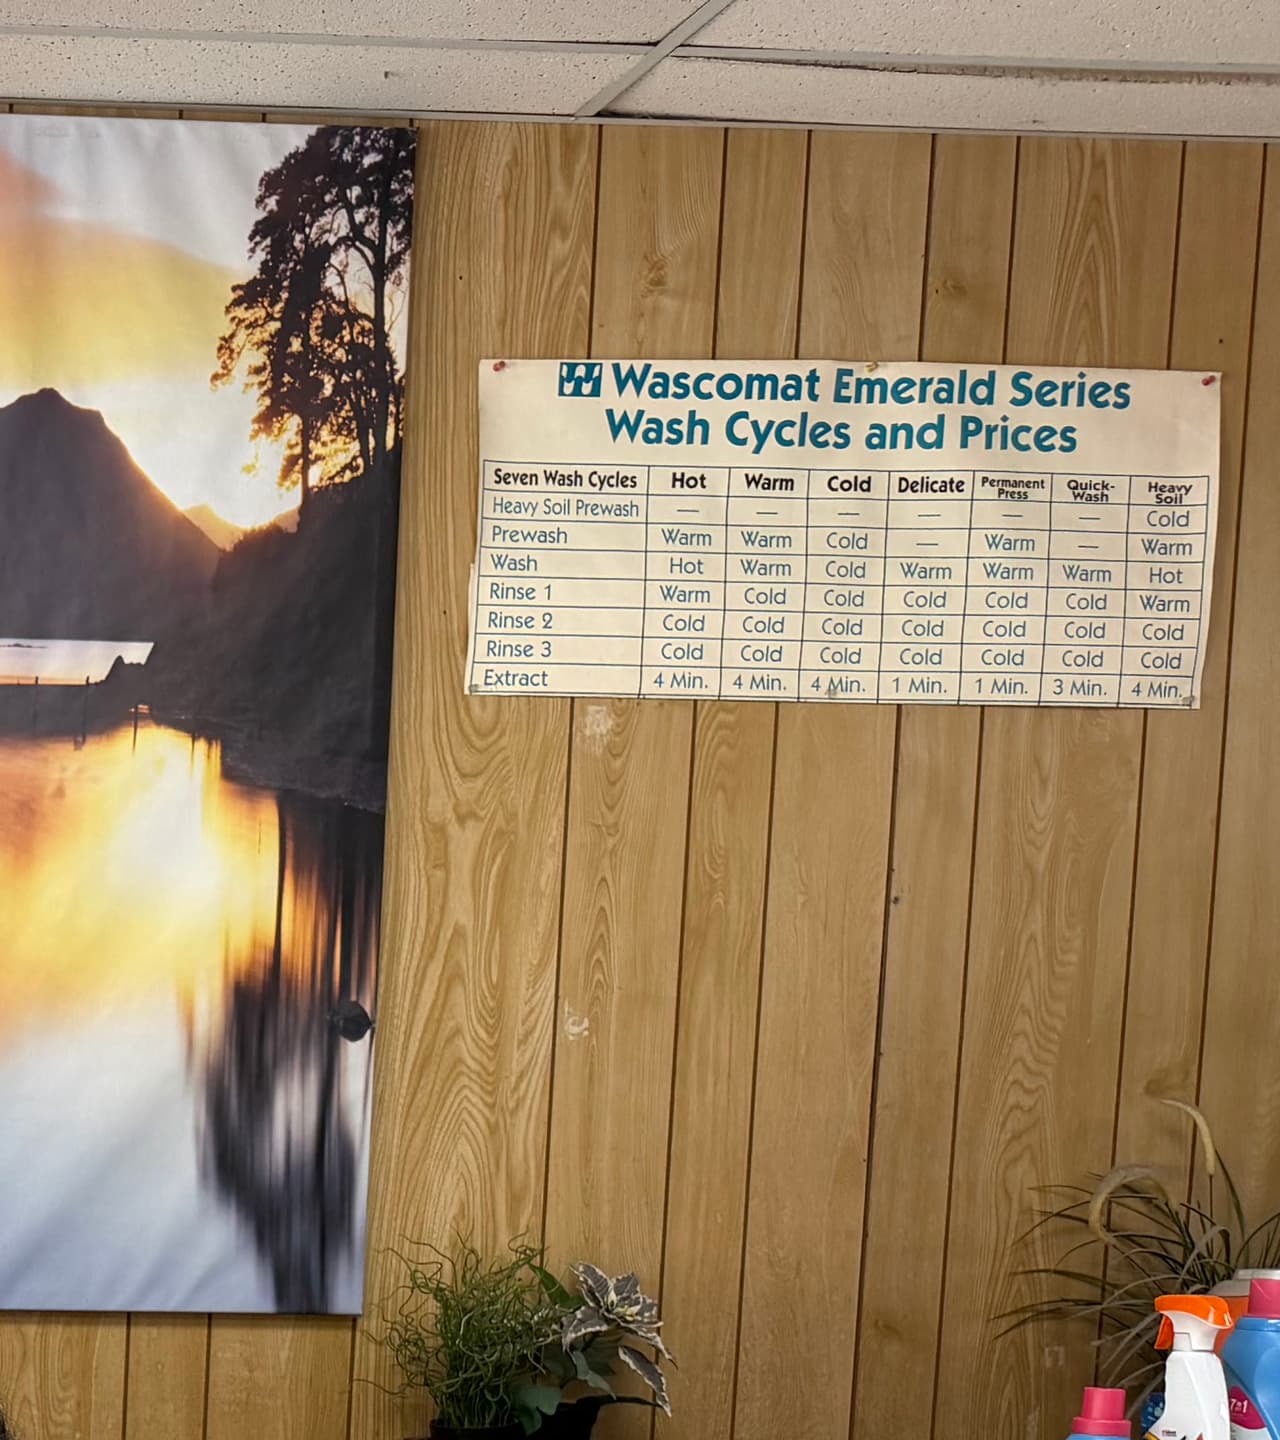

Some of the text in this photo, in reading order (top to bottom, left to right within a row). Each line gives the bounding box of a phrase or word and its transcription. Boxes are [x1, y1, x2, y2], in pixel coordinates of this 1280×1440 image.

[612, 362, 1131, 409] Wascomat Emerald Series
[606, 408, 1077, 454] Wash Cycles and Prices
[494, 468, 638, 489] Seven Wash Cycles
[671, 473, 707, 490] Hot
[744, 474, 795, 491] Warm
[827, 476, 871, 493] Cold
[898, 476, 965, 494] Delicate
[981, 477, 1045, 490] Permanent
[1067, 479, 1115, 493] Quick-
[998, 488, 1029, 501] Press
[1072, 490, 1109, 503] Wash
[1148, 481, 1193, 495] Heavy
[493, 497, 639, 517] Heavy Soil Prewash
[1155, 492, 1183, 505] Soil
[1147, 510, 1190, 528] Cold
[492, 526, 568, 545] Prewash
[661, 528, 712, 547] Warm
[741, 531, 792, 549] Warm
[826, 532, 868, 550] Cold
[985, 534, 1036, 552] Warm
[1141, 538, 1193, 556] Warm
[490, 553, 538, 572] Wash
[669, 557, 704, 575] Hot
[740, 559, 791, 577] Warm
[825, 560, 866, 579] Cold
[900, 562, 952, 581] Warm
[983, 563, 1034, 581] Warm
[1062, 564, 1112, 583] Warm
[1149, 566, 1183, 584] Hot
[490, 583, 552, 601] Rinse 1
[660, 585, 711, 604] Warm
[744, 588, 786, 606] Cold
[824, 589, 864, 607] Cold
[904, 591, 947, 609] Cold
[985, 591, 1028, 610] Cold
[1065, 593, 1108, 611] Cold
[1139, 594, 1190, 613] Warm
[488, 611, 553, 629] Rinse 2
[487, 640, 552, 658] Rinse 3
[484, 669, 549, 688] Extract
[653, 671, 708, 690] 4 Min.
